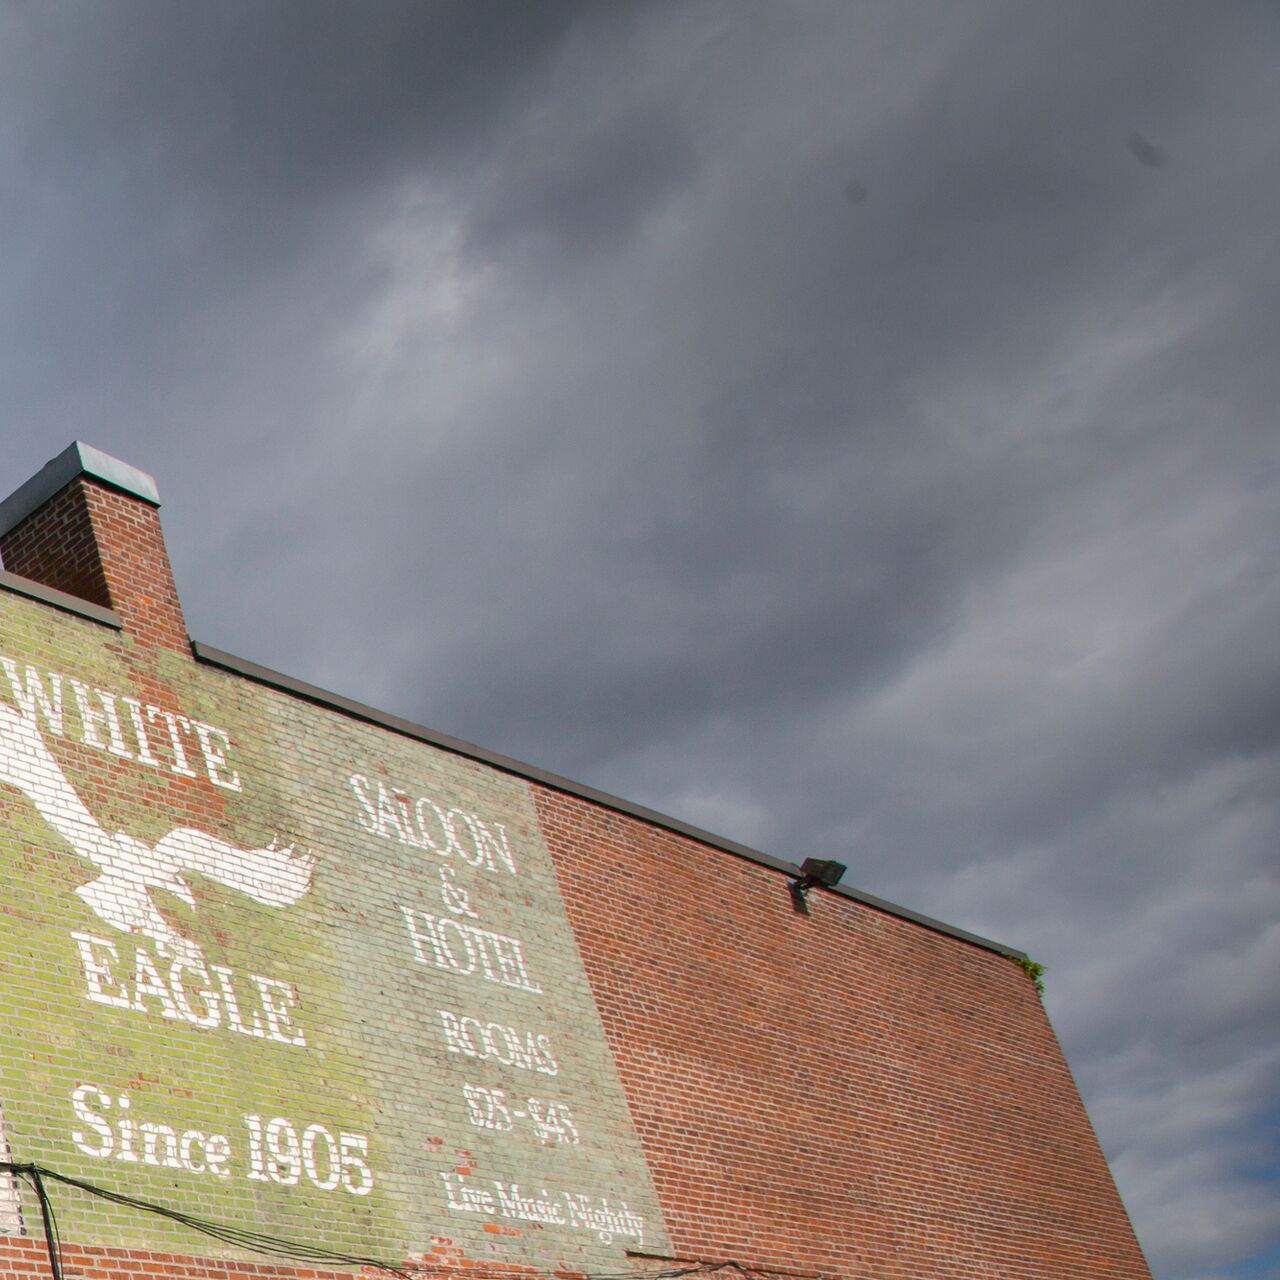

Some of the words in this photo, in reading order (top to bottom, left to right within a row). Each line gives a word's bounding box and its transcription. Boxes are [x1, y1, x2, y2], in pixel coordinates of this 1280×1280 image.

[350, 774, 518, 876] SALOON
[440, 864, 479, 918] &
[70, 932, 306, 1046] EAGLE
[399, 905, 543, 993] HOTEL
[436, 1009, 558, 1076] ROOMS
[71, 1085, 231, 1178] Since
[244, 1114, 374, 1196] 1905
[440, 1172, 496, 1214] Live
[494, 1181, 566, 1225] Music
[562, 1191, 644, 1249] Nightly
